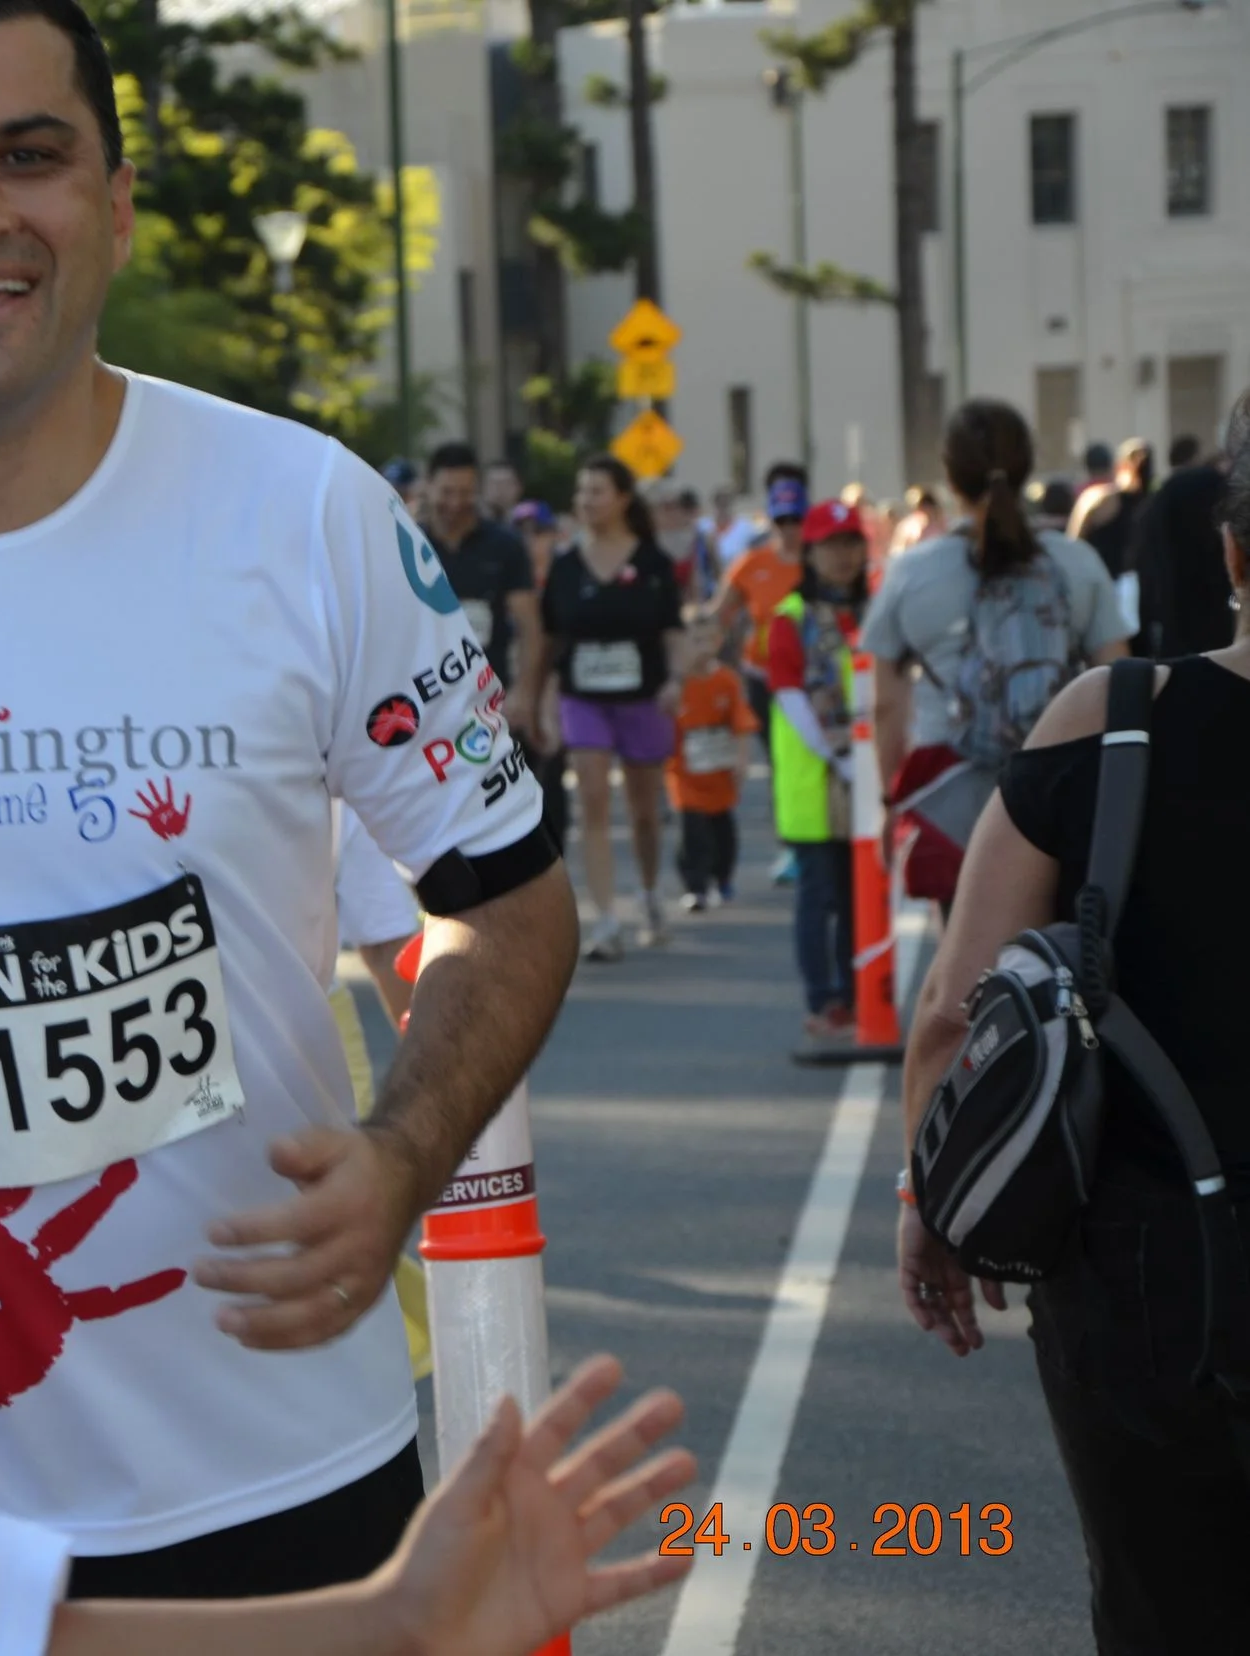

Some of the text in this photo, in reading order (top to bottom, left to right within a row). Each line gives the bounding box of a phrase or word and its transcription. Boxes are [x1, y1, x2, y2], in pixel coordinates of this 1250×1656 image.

[67, 776, 117, 844] 5
[29, 950, 63, 976] for
[31, 973, 68, 999] the
[440, 1171, 525, 1203] ERVICES
